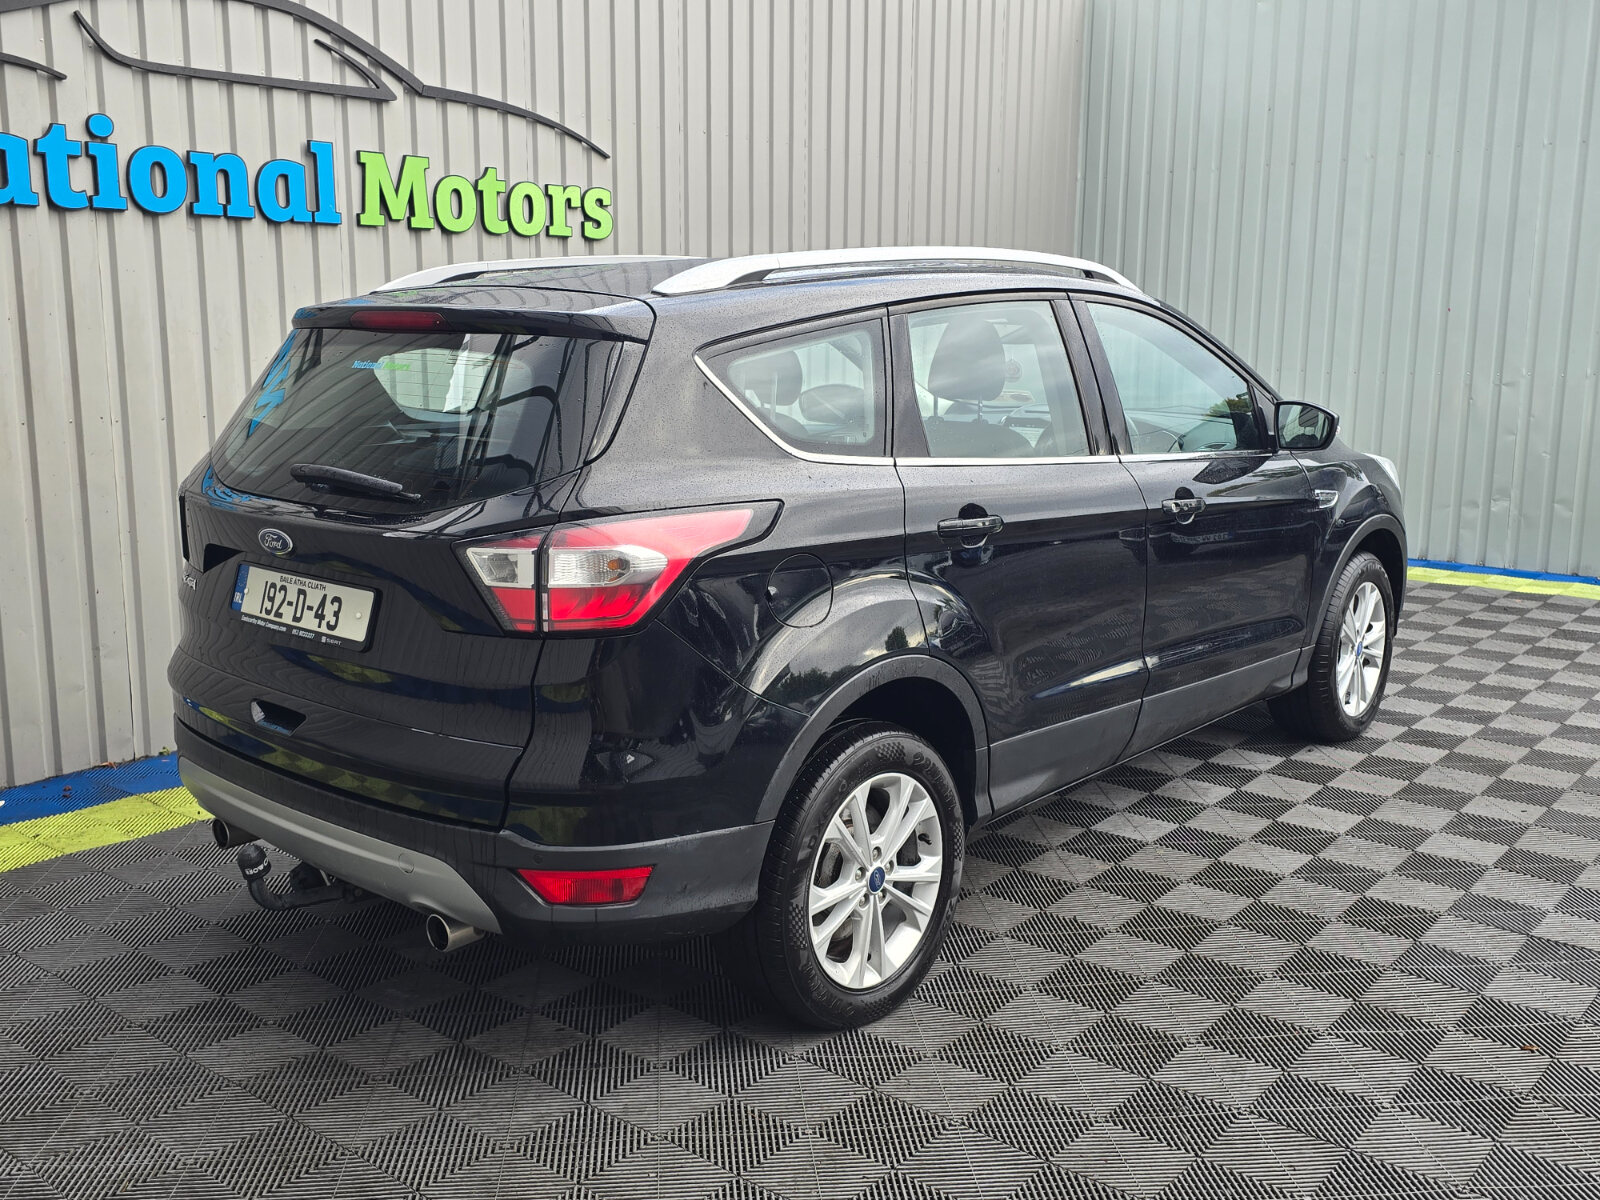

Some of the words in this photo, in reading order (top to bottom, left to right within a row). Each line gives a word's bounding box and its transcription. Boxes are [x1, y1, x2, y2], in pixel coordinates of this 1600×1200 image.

[355, 149, 614, 241] Motors
[352, 360, 385, 370] National
[280, 575, 293, 585] BAILE
[307, 581, 327, 592] CLIATH
[260, 580, 343, 631] 192-D-43
